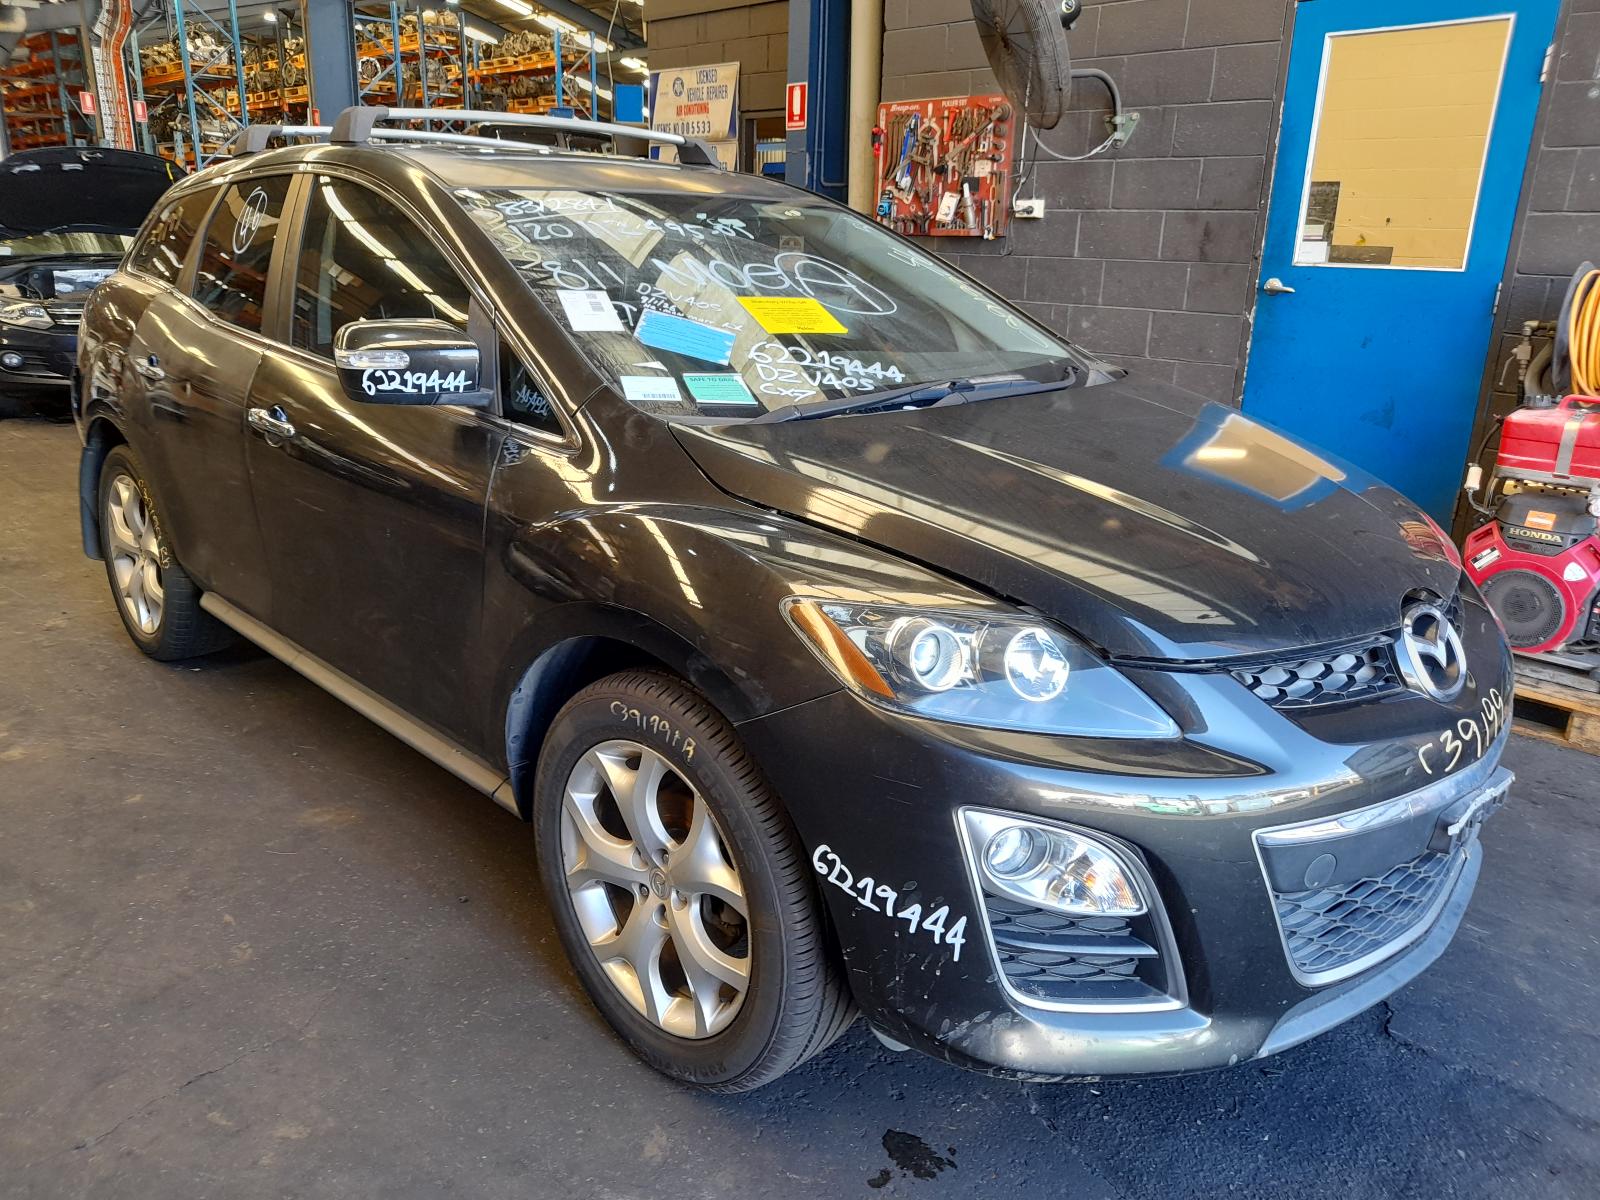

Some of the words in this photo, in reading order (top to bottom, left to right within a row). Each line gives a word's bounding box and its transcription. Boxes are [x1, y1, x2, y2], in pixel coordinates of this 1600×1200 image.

[696, 69, 717, 84] LICENSED
[687, 86, 704, 102] VEHICLE
[706, 84, 728, 100] REPAIRER
[748, 341, 905, 383] 62219444
[362, 369, 472, 395] 62219444
[1509, 527, 1562, 543] HONDA
[812, 844, 968, 962] 62219444
